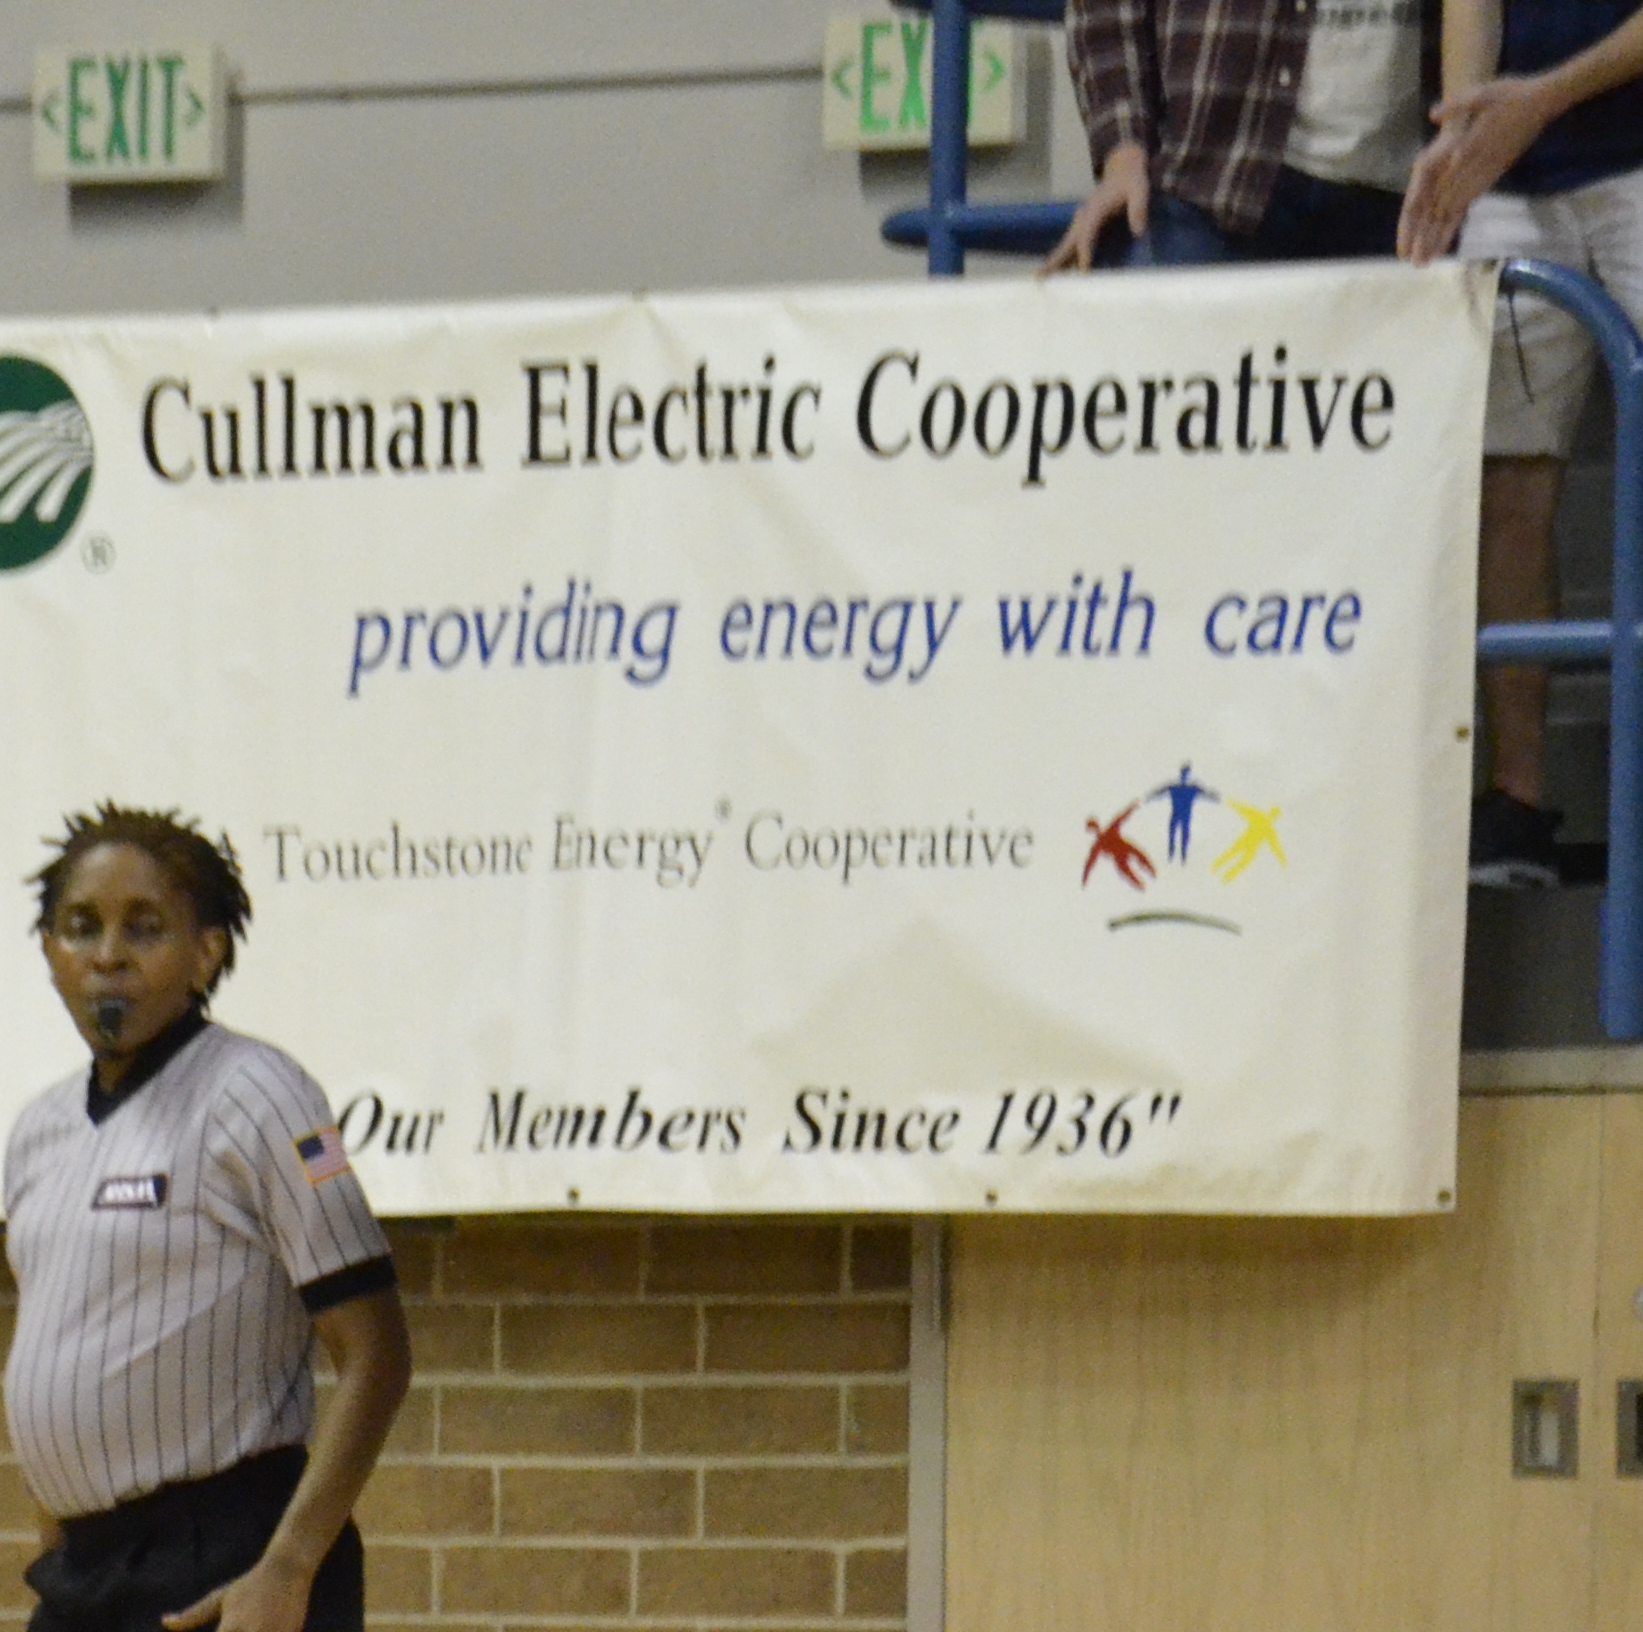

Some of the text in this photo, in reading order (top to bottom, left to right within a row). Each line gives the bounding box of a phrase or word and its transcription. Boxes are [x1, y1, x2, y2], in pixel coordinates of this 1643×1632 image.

[68, 55, 185, 162] EXIT
[861, 18, 977, 130] EX
[140, 343, 1395, 488] Cullman Electric Cooperative
[347, 565, 1365, 700] providing energy with care
[263, 818, 535, 884] Touchstone
[552, 812, 717, 890] Energy
[744, 808, 1036, 887] Cooperative
[337, 1086, 445, 1156] Our
[476, 1084, 746, 1156] Members
[781, 1086, 963, 1158] Since
